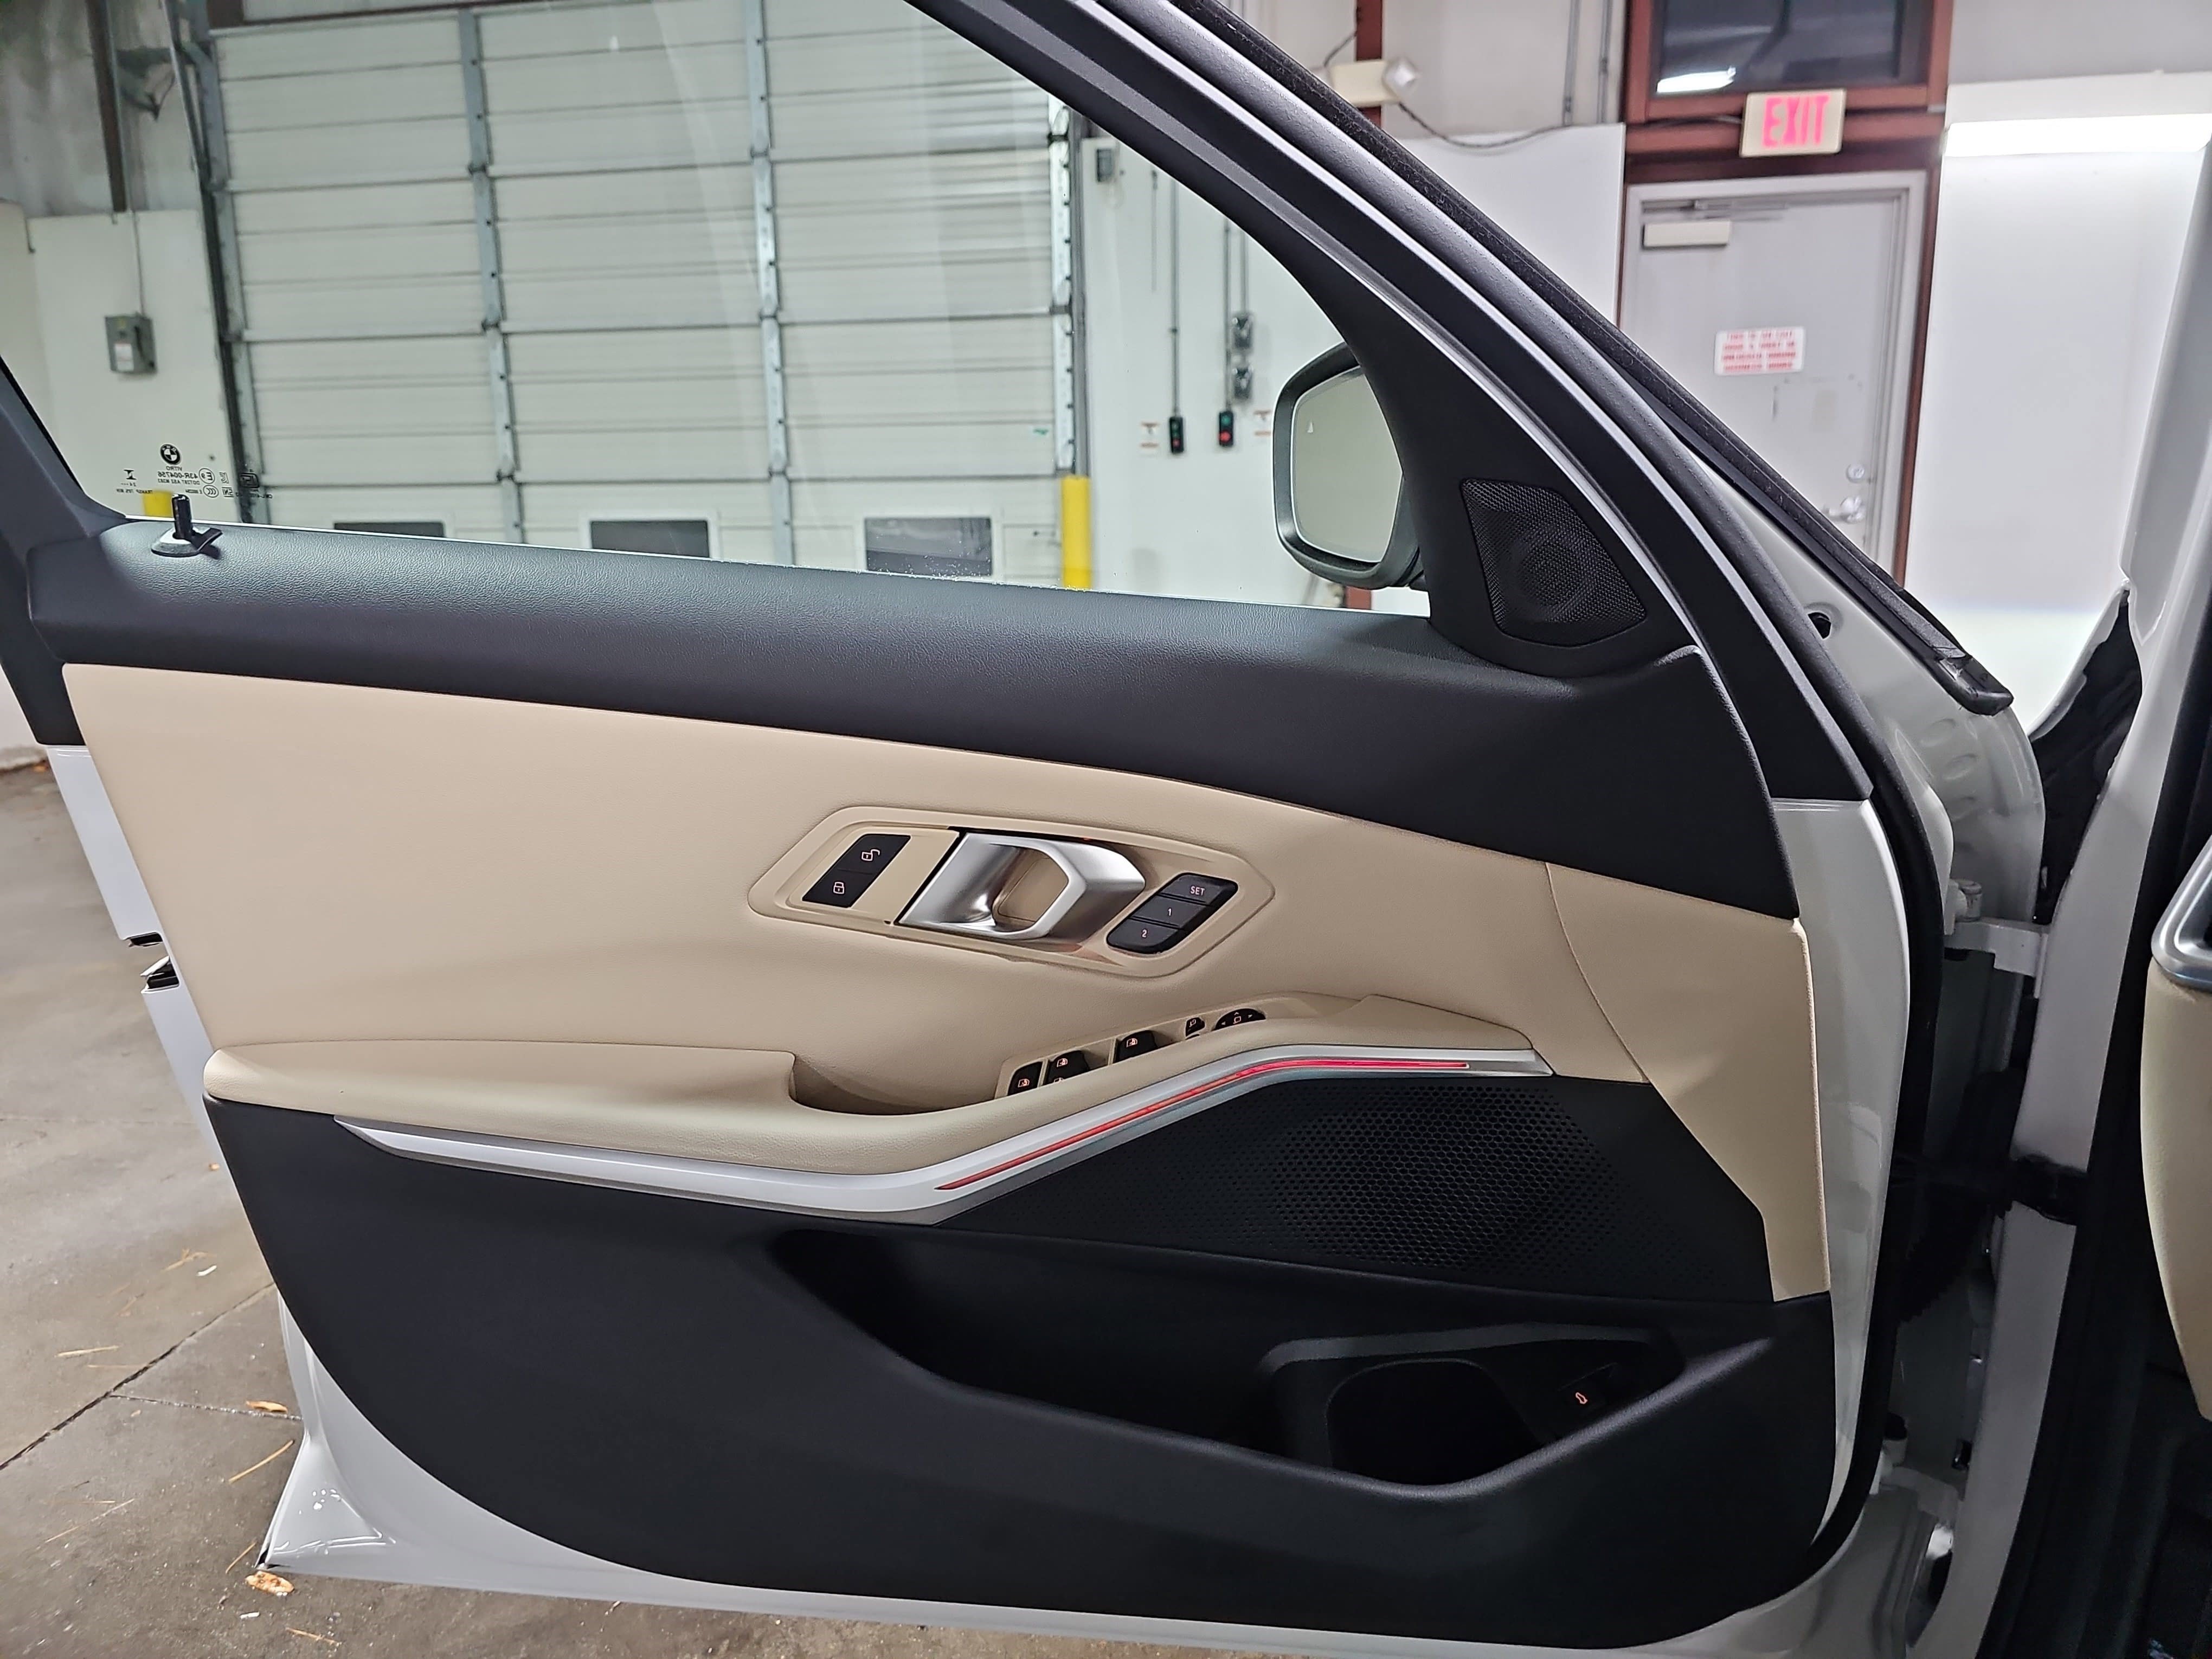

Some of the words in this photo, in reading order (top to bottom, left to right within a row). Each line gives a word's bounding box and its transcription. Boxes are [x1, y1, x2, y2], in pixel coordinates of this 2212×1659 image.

[1763, 96, 1830, 147] EXIT
[1190, 886, 1205, 896] SET
[1141, 929, 1147, 937] 2
